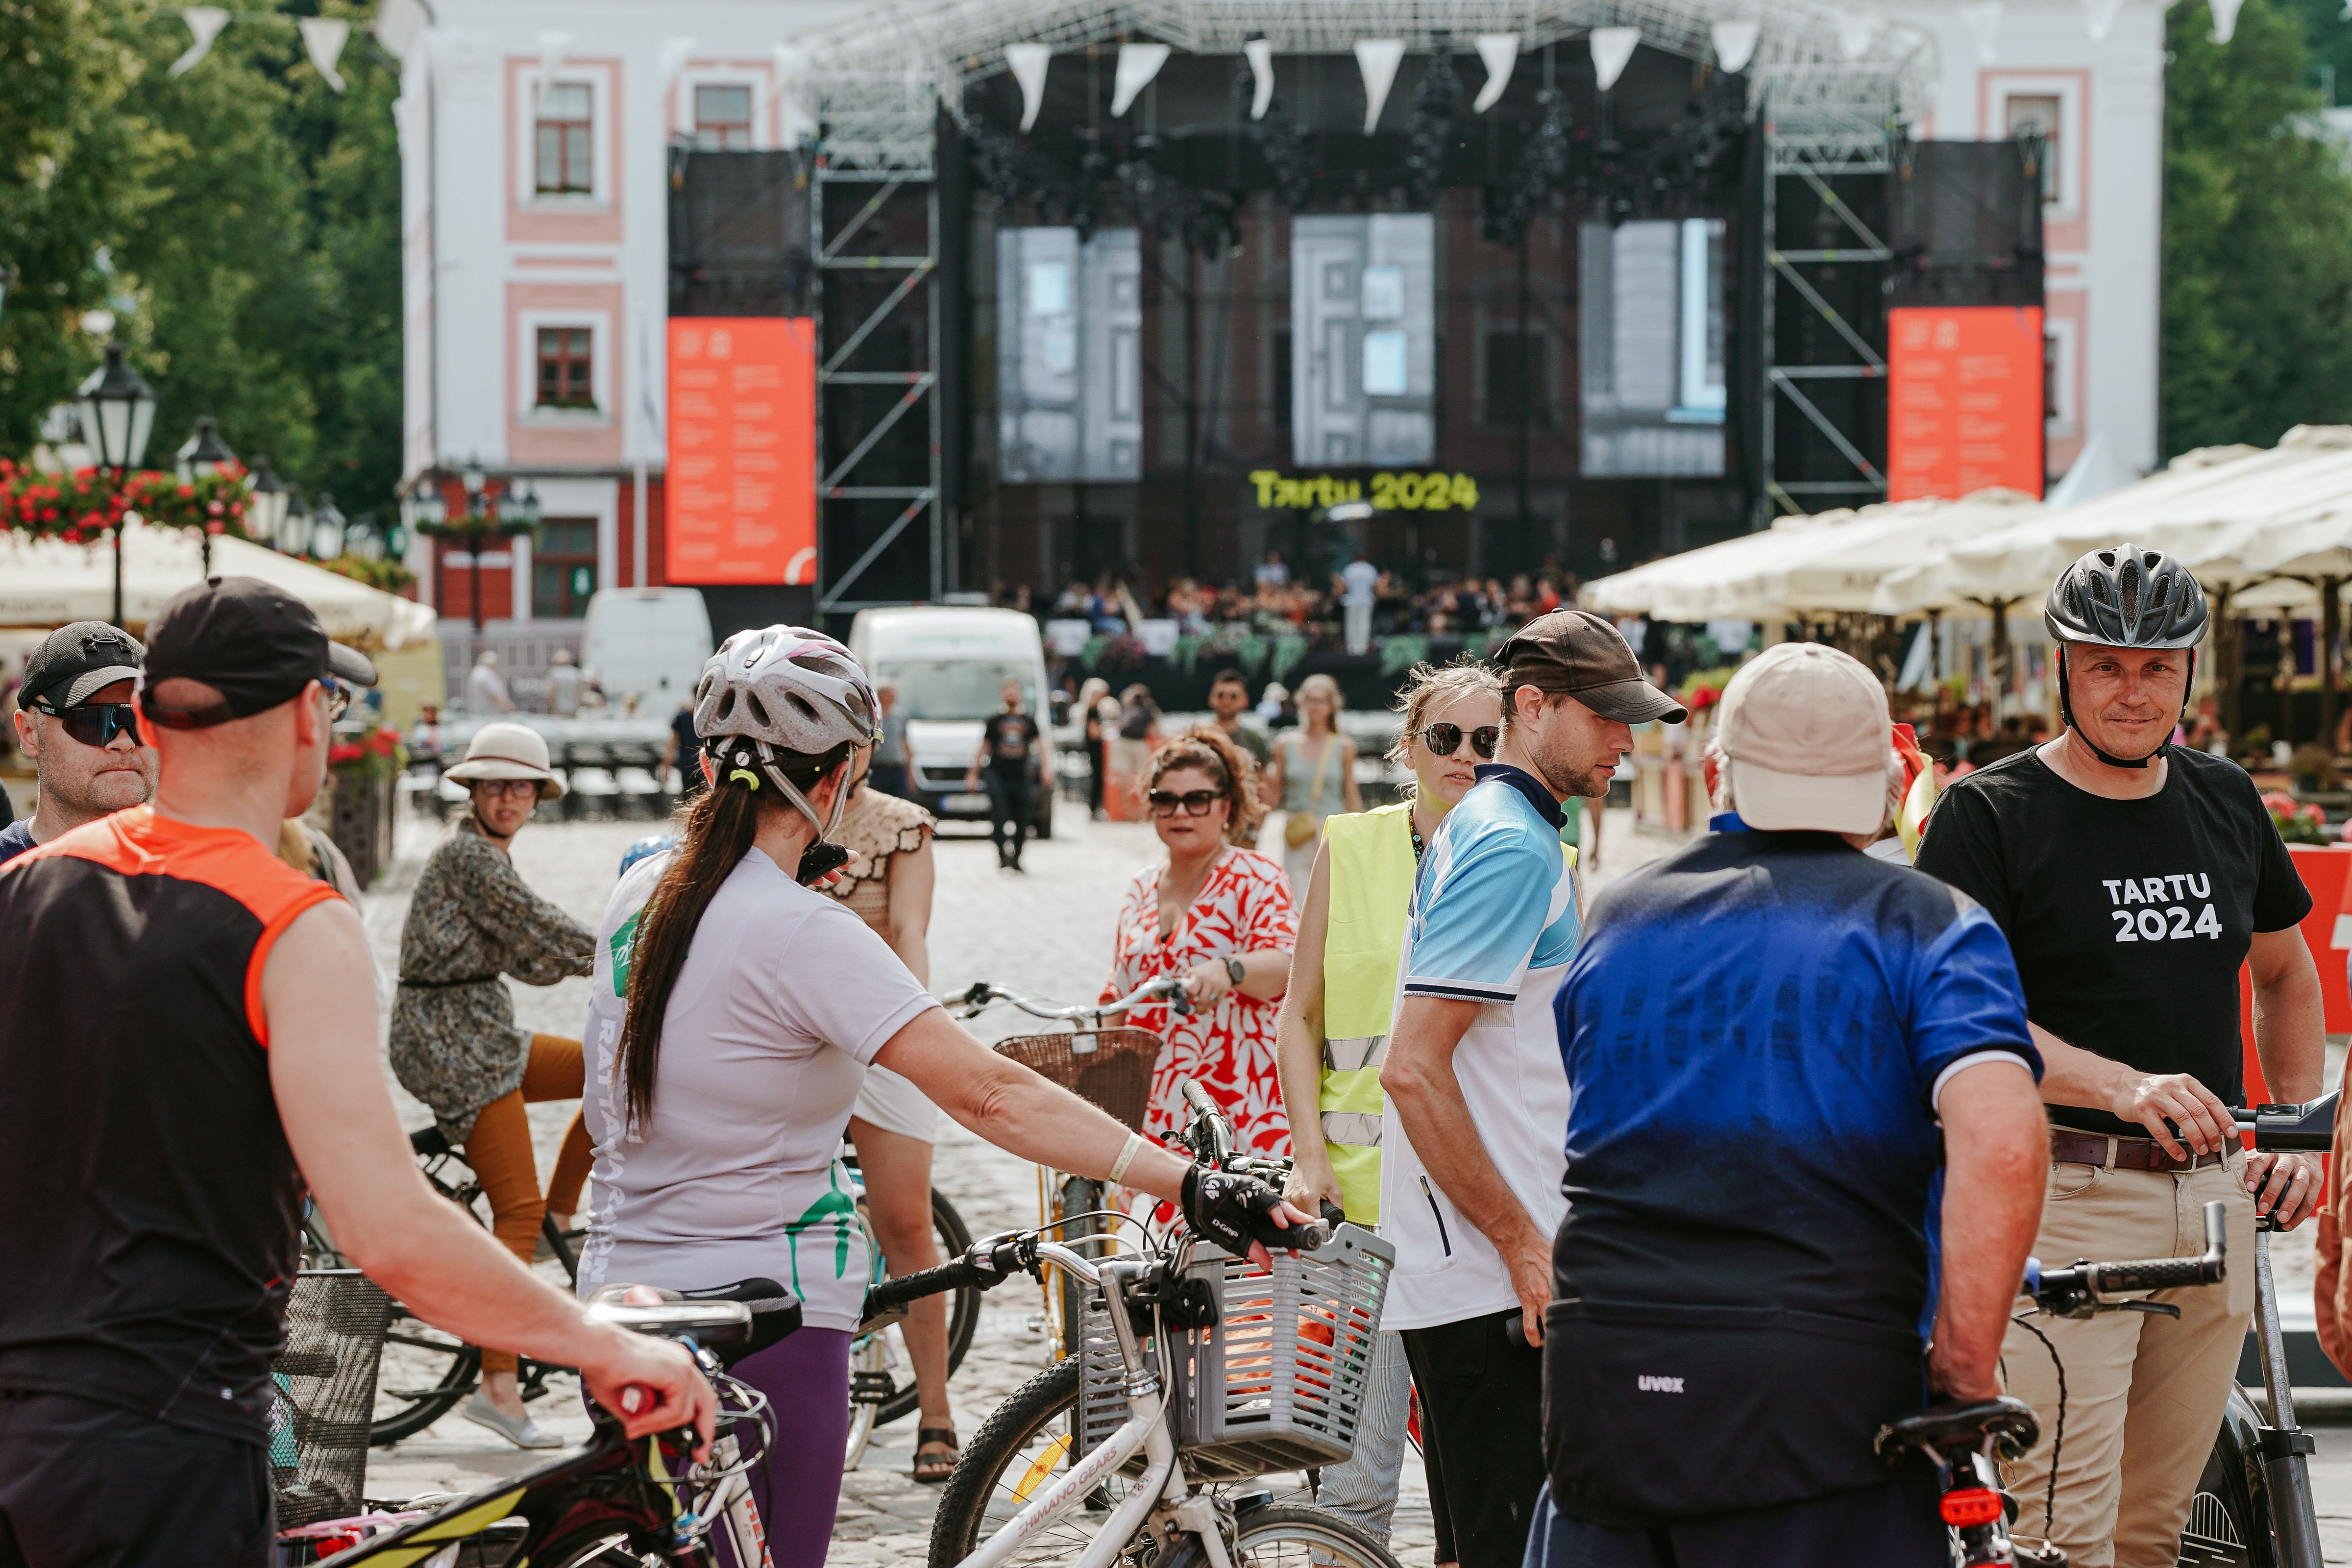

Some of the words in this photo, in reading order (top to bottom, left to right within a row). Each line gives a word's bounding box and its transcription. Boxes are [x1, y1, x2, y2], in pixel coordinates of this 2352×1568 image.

[1249, 469, 1361, 509] Tartu
[1370, 471, 1480, 511] 2024
[2102, 873, 2211, 905] TARTU
[2111, 903, 2222, 942] 2024
[1638, 1374, 1685, 1393] uvex
[1018, 1481, 1077, 1537] SHIMANO
[1078, 1445, 1117, 1485] GEARS
